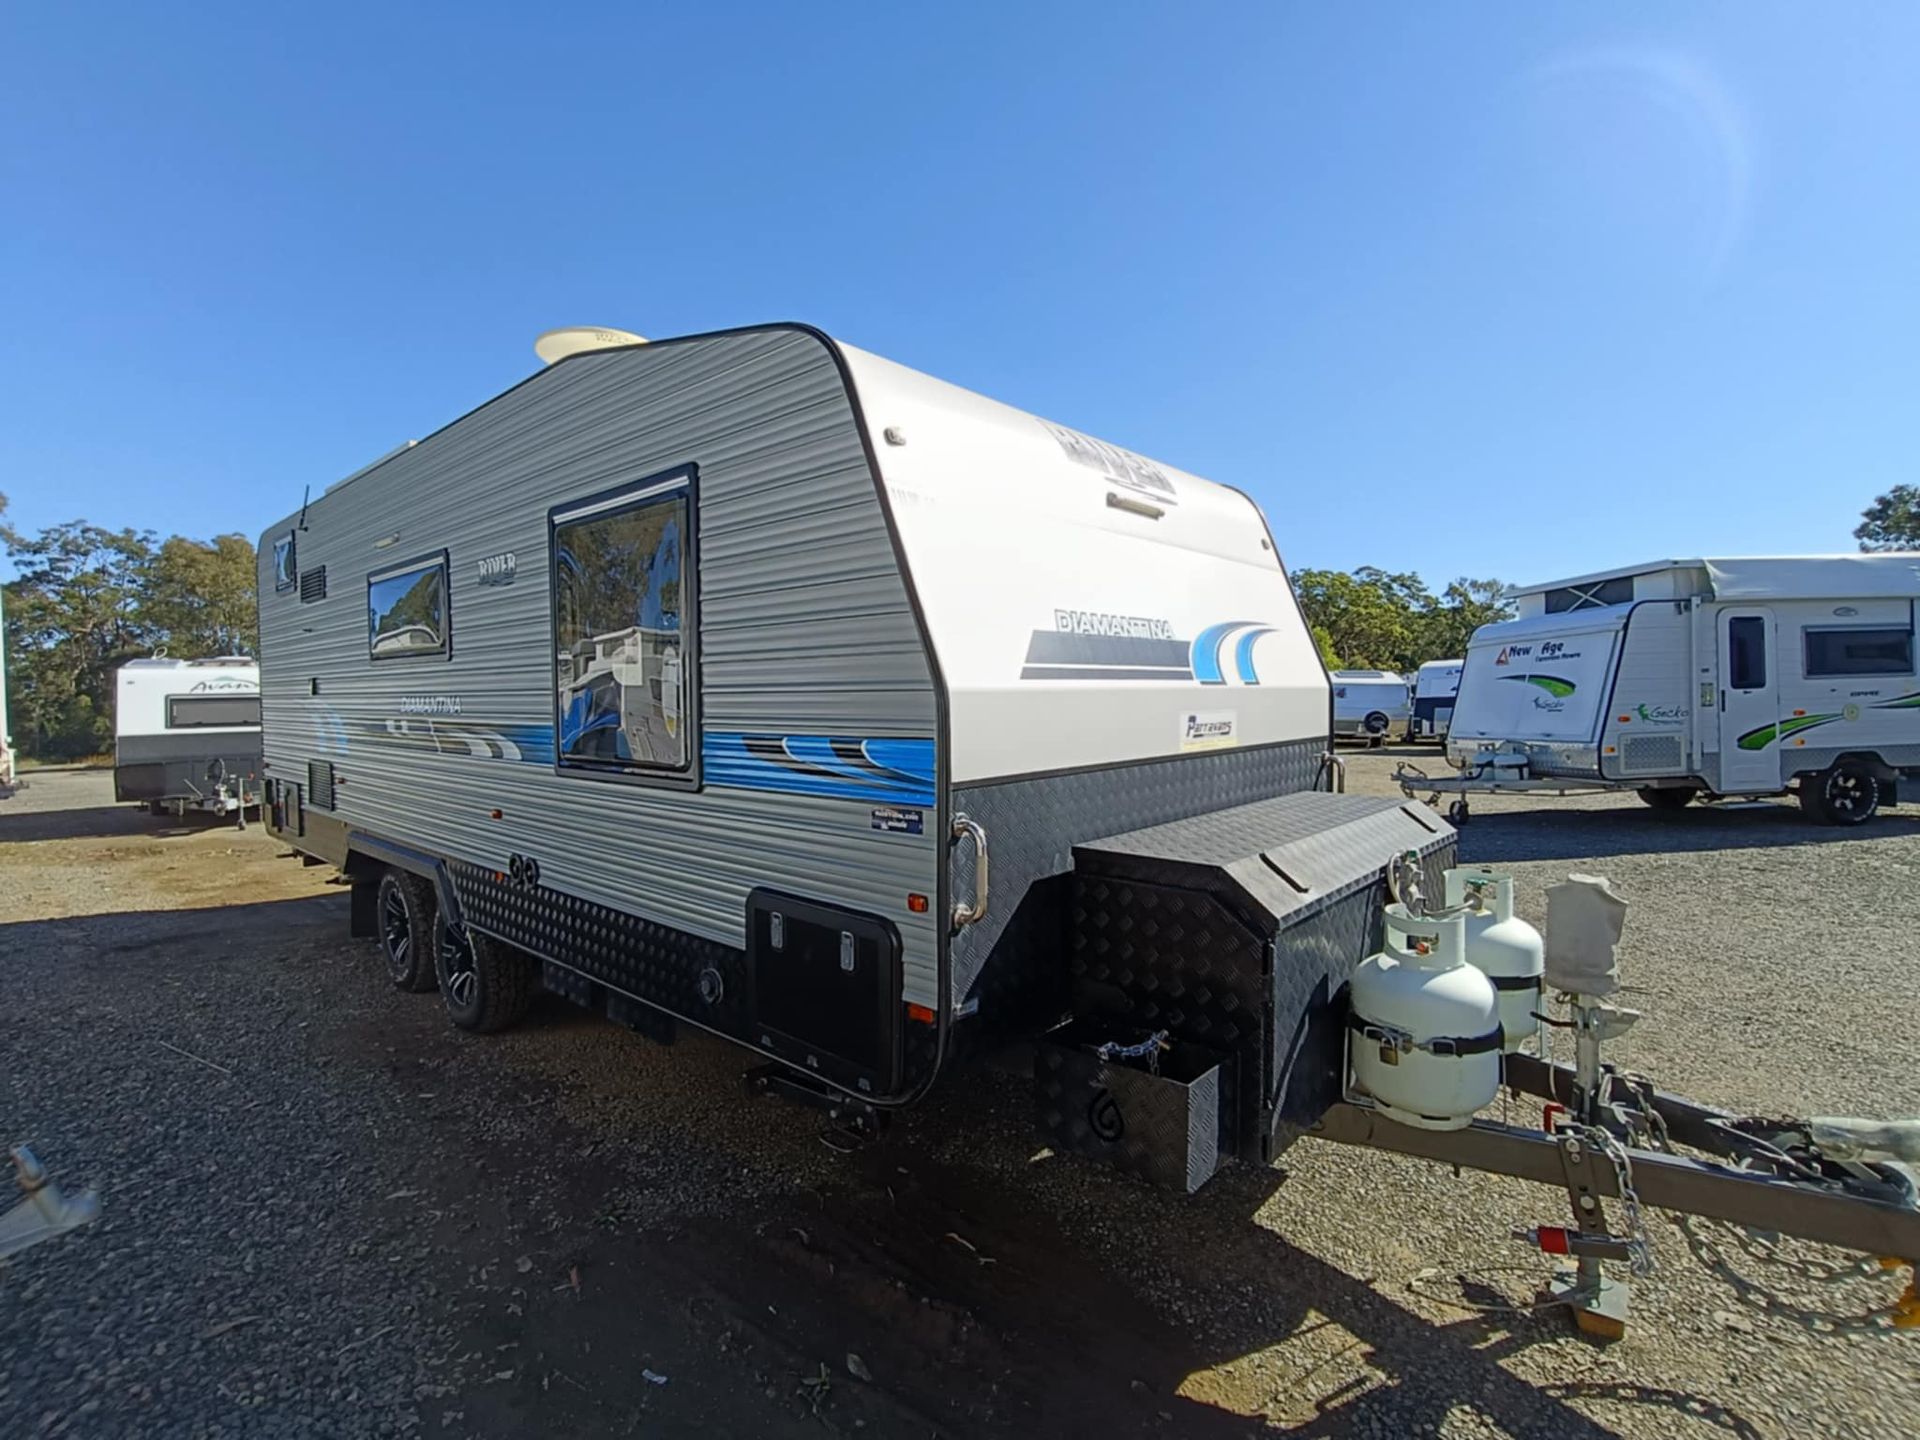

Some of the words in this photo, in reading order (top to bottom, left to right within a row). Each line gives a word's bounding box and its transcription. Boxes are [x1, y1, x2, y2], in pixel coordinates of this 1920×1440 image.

[478, 553, 516, 577] RIVER
[1054, 609, 1176, 640] DIAMANTINA
[1509, 646, 1532, 657] New
[1541, 642, 1564, 656] Age
[401, 696, 461, 713] DIAMANTINA
[1650, 706, 1689, 718] Gecko
